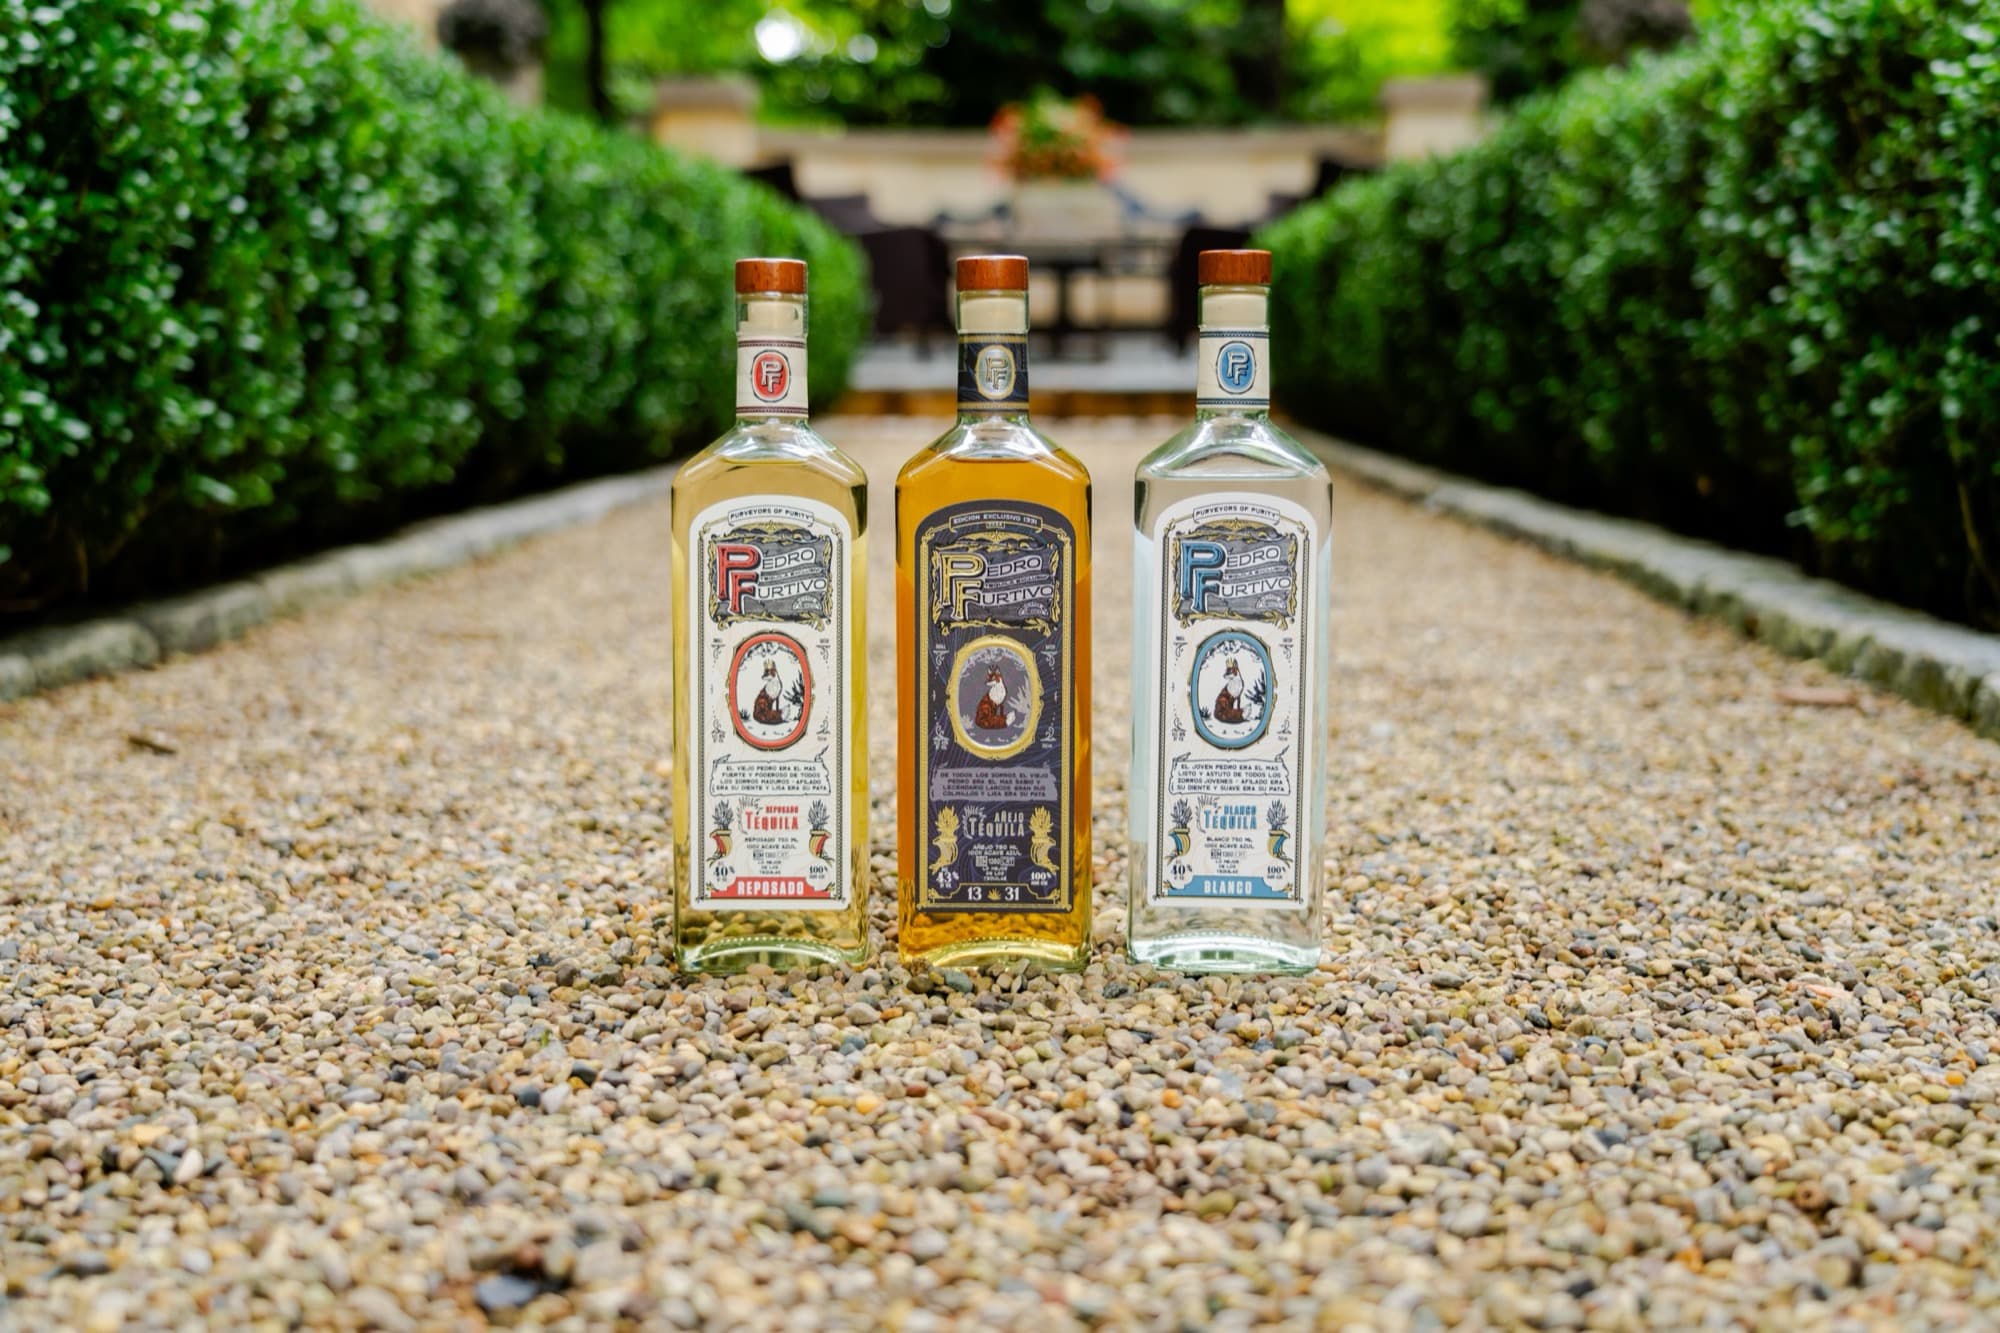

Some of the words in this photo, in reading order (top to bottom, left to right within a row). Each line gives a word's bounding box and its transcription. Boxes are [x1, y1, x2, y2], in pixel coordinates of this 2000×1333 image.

[730, 508, 771, 519] PURVEYORS
[785, 510, 809, 519] PURITY
[983, 513, 1021, 522] EXCLUSIVO
[1196, 506, 1237, 517] PURVEYORS
[1251, 507, 1276, 518] PURITY
[717, 544, 815, 600] PEDRO
[940, 552, 1041, 606] PEDRO
[1181, 542, 1280, 600] PEDRO
[729, 571, 827, 614] FURTIVO
[952, 578, 1054, 620] FURTIVO
[1192, 569, 1291, 612] FURTIVO
[994, 810, 1024, 823] AÑEJO
[1204, 809, 1257, 830] TEQUILA
[1224, 805, 1257, 815] BLANCO
[745, 811, 798, 830] TEQUILA
[968, 817, 1025, 838] TEQUILA
[737, 881, 804, 895] REPOSADO
[967, 887, 982, 901] 13
[1004, 887, 1020, 901] 31
[1204, 880, 1252, 894] BLANCO
